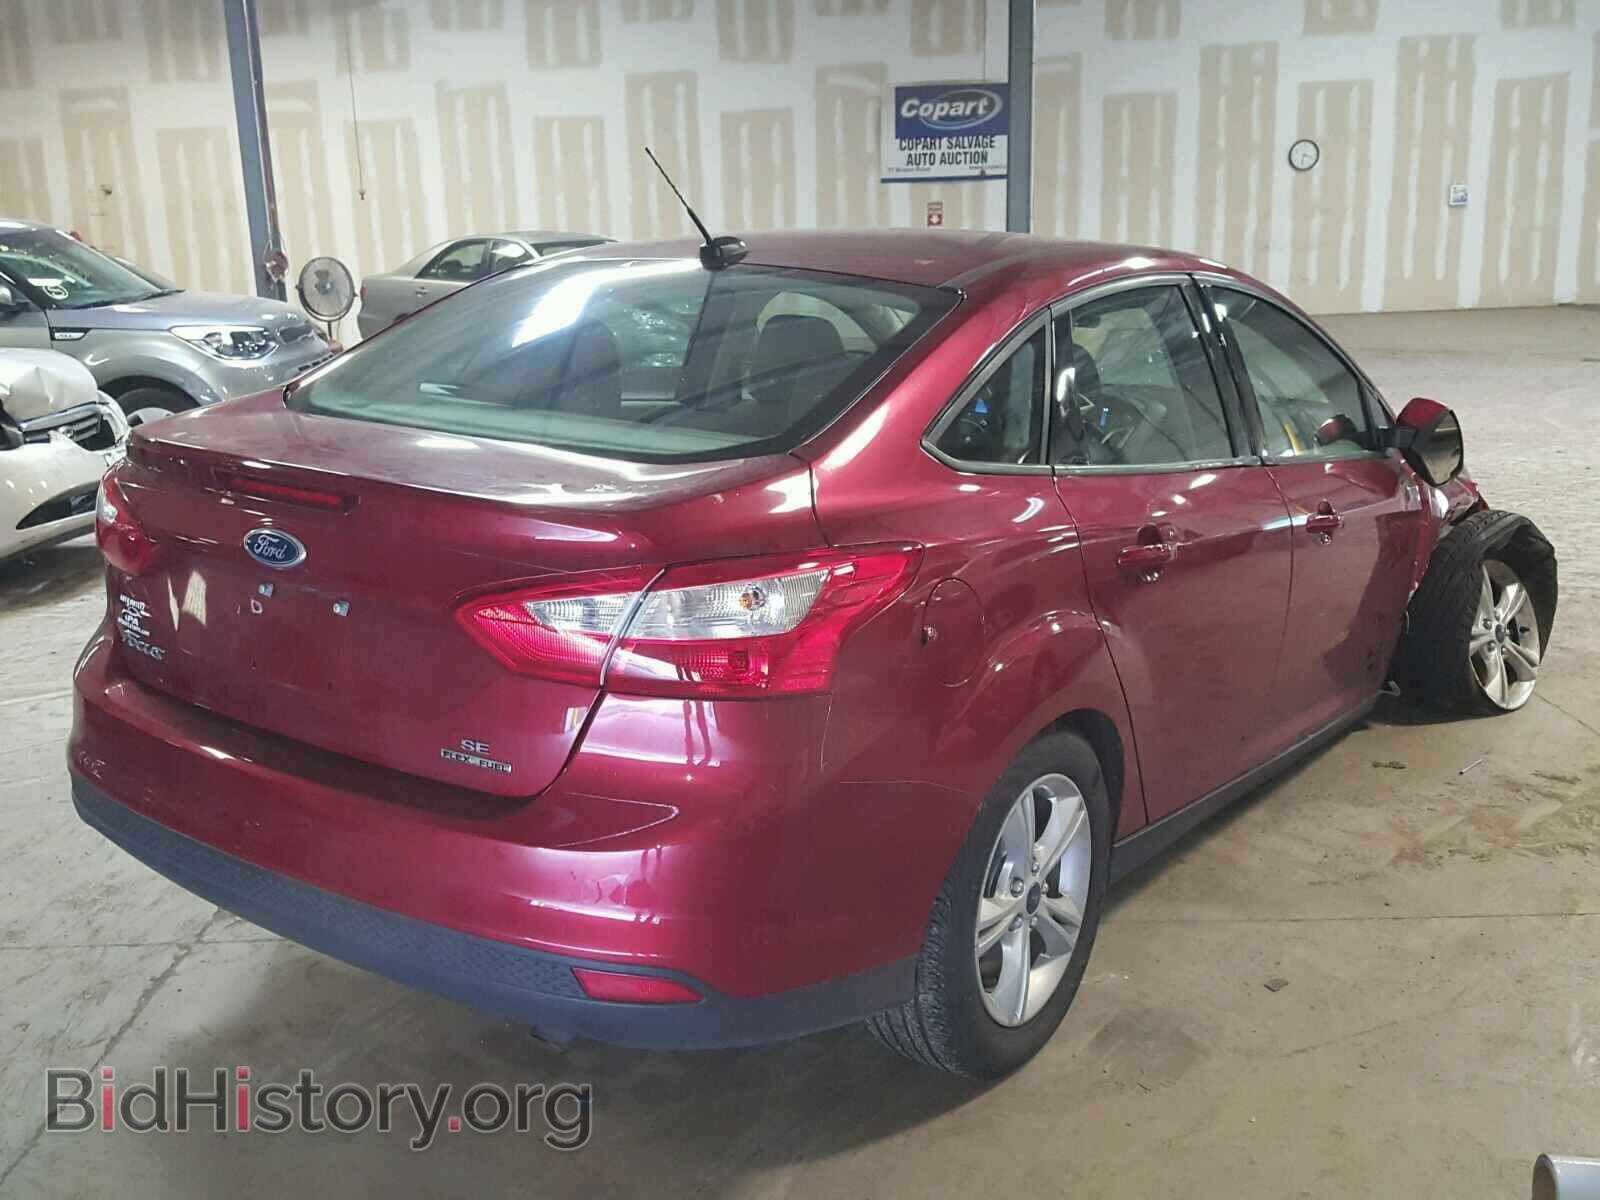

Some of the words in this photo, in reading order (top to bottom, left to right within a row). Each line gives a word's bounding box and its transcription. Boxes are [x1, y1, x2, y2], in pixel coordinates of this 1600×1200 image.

[901, 97, 988, 120] Copart
[899, 137, 942, 151] COPART
[946, 135, 995, 150] SALVAGE
[906, 151, 936, 166] AUTO
[939, 150, 988, 165] AUCTION
[254, 534, 288, 559] Ford
[461, 739, 490, 755] SE
[443, 750, 471, 764] FLEX
[479, 760, 511, 773] FUEL
